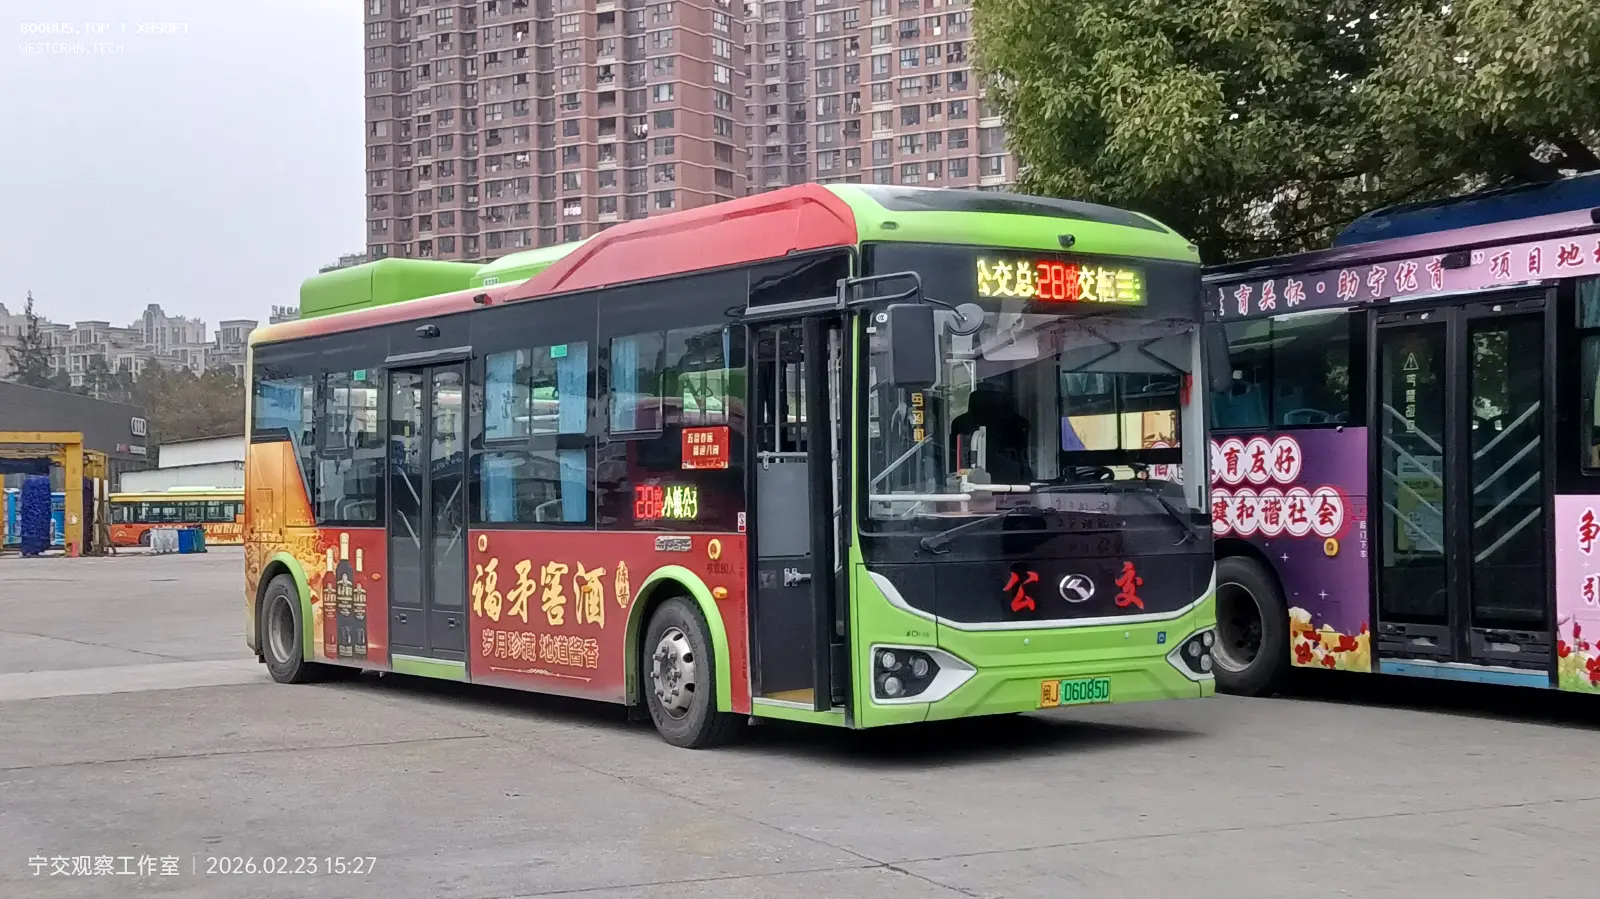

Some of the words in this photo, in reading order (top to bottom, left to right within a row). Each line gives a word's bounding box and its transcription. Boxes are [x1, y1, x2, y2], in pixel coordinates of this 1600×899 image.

[482, 629, 536, 661] 岁月珍藏
[539, 633, 600, 668] 地道酱香
